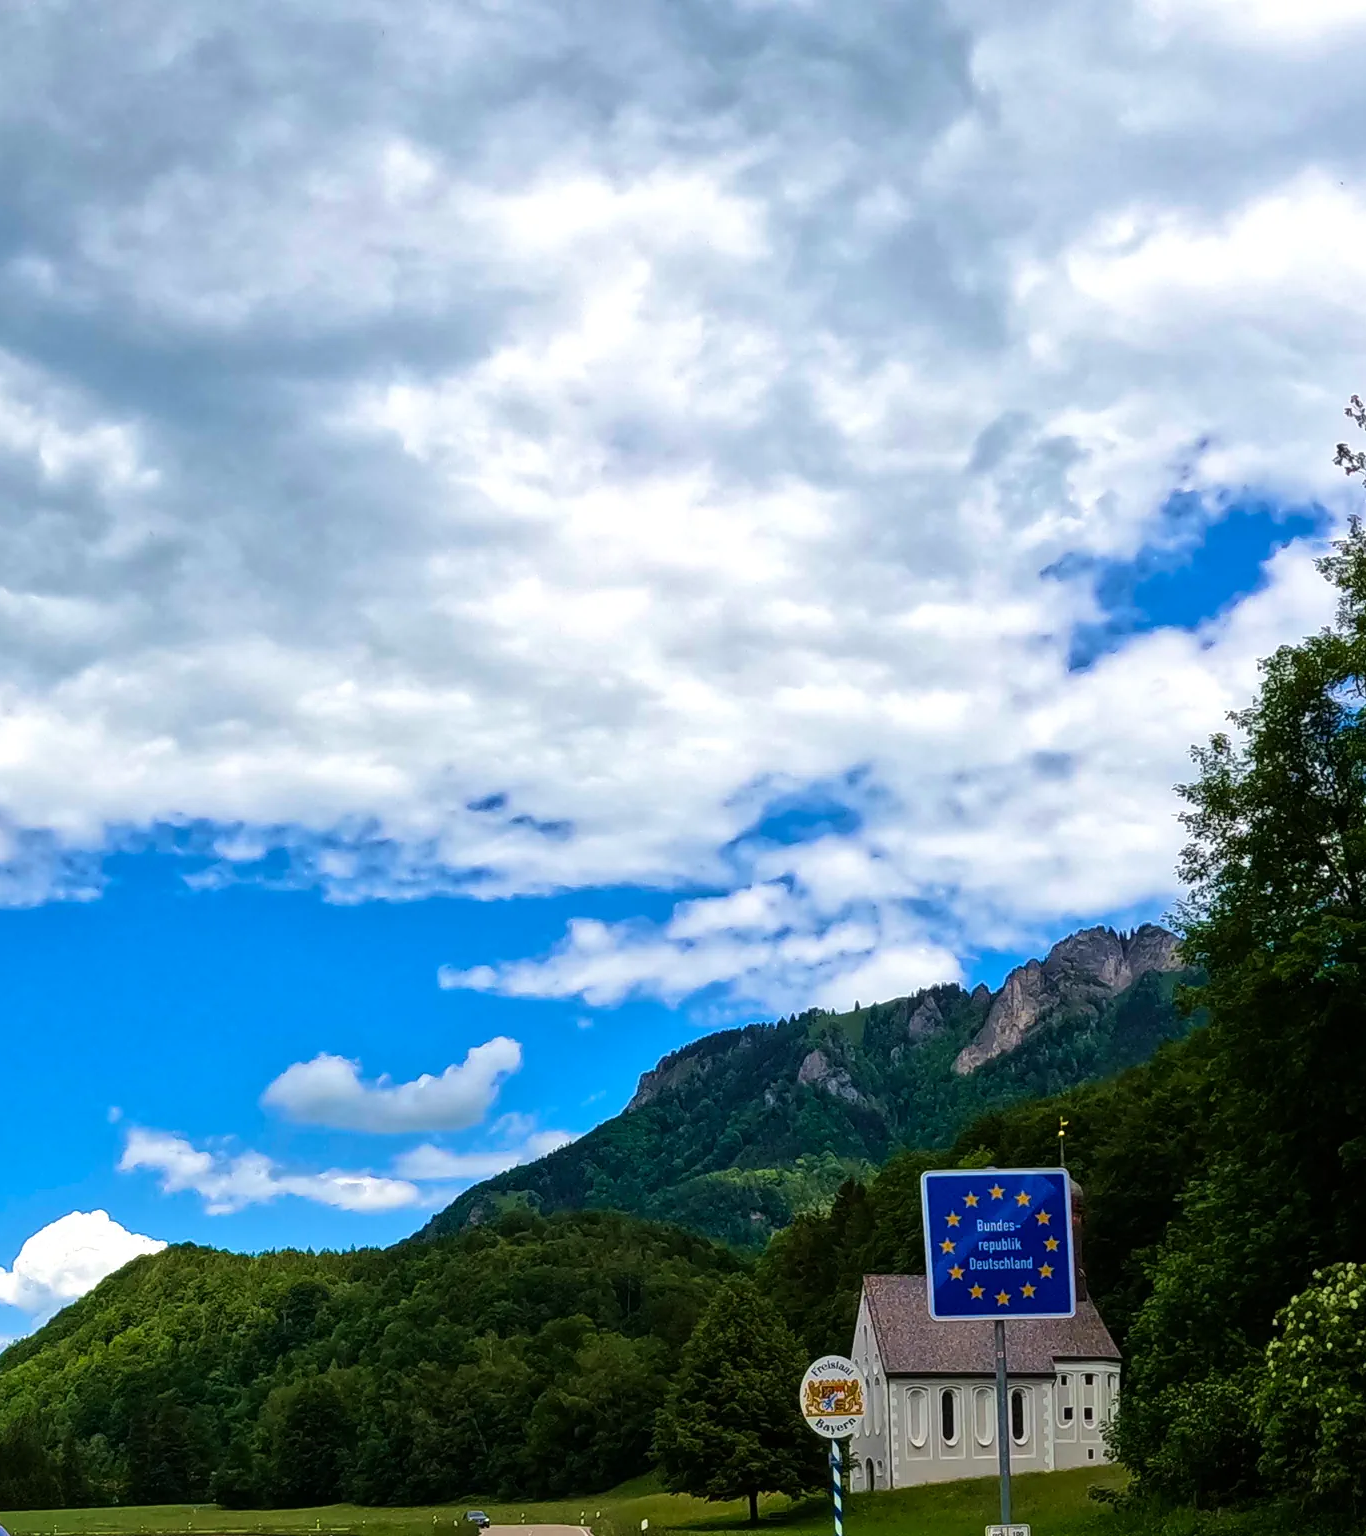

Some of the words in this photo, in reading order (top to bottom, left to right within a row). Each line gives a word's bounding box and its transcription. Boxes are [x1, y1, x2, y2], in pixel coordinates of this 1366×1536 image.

[976, 1219, 1021, 1232] Bundes-
[978, 1237, 1022, 1253] republik
[969, 1256, 1033, 1270] Deutschland
[811, 1360, 855, 1377] Freistaat
[815, 1417, 857, 1435] Bayern
